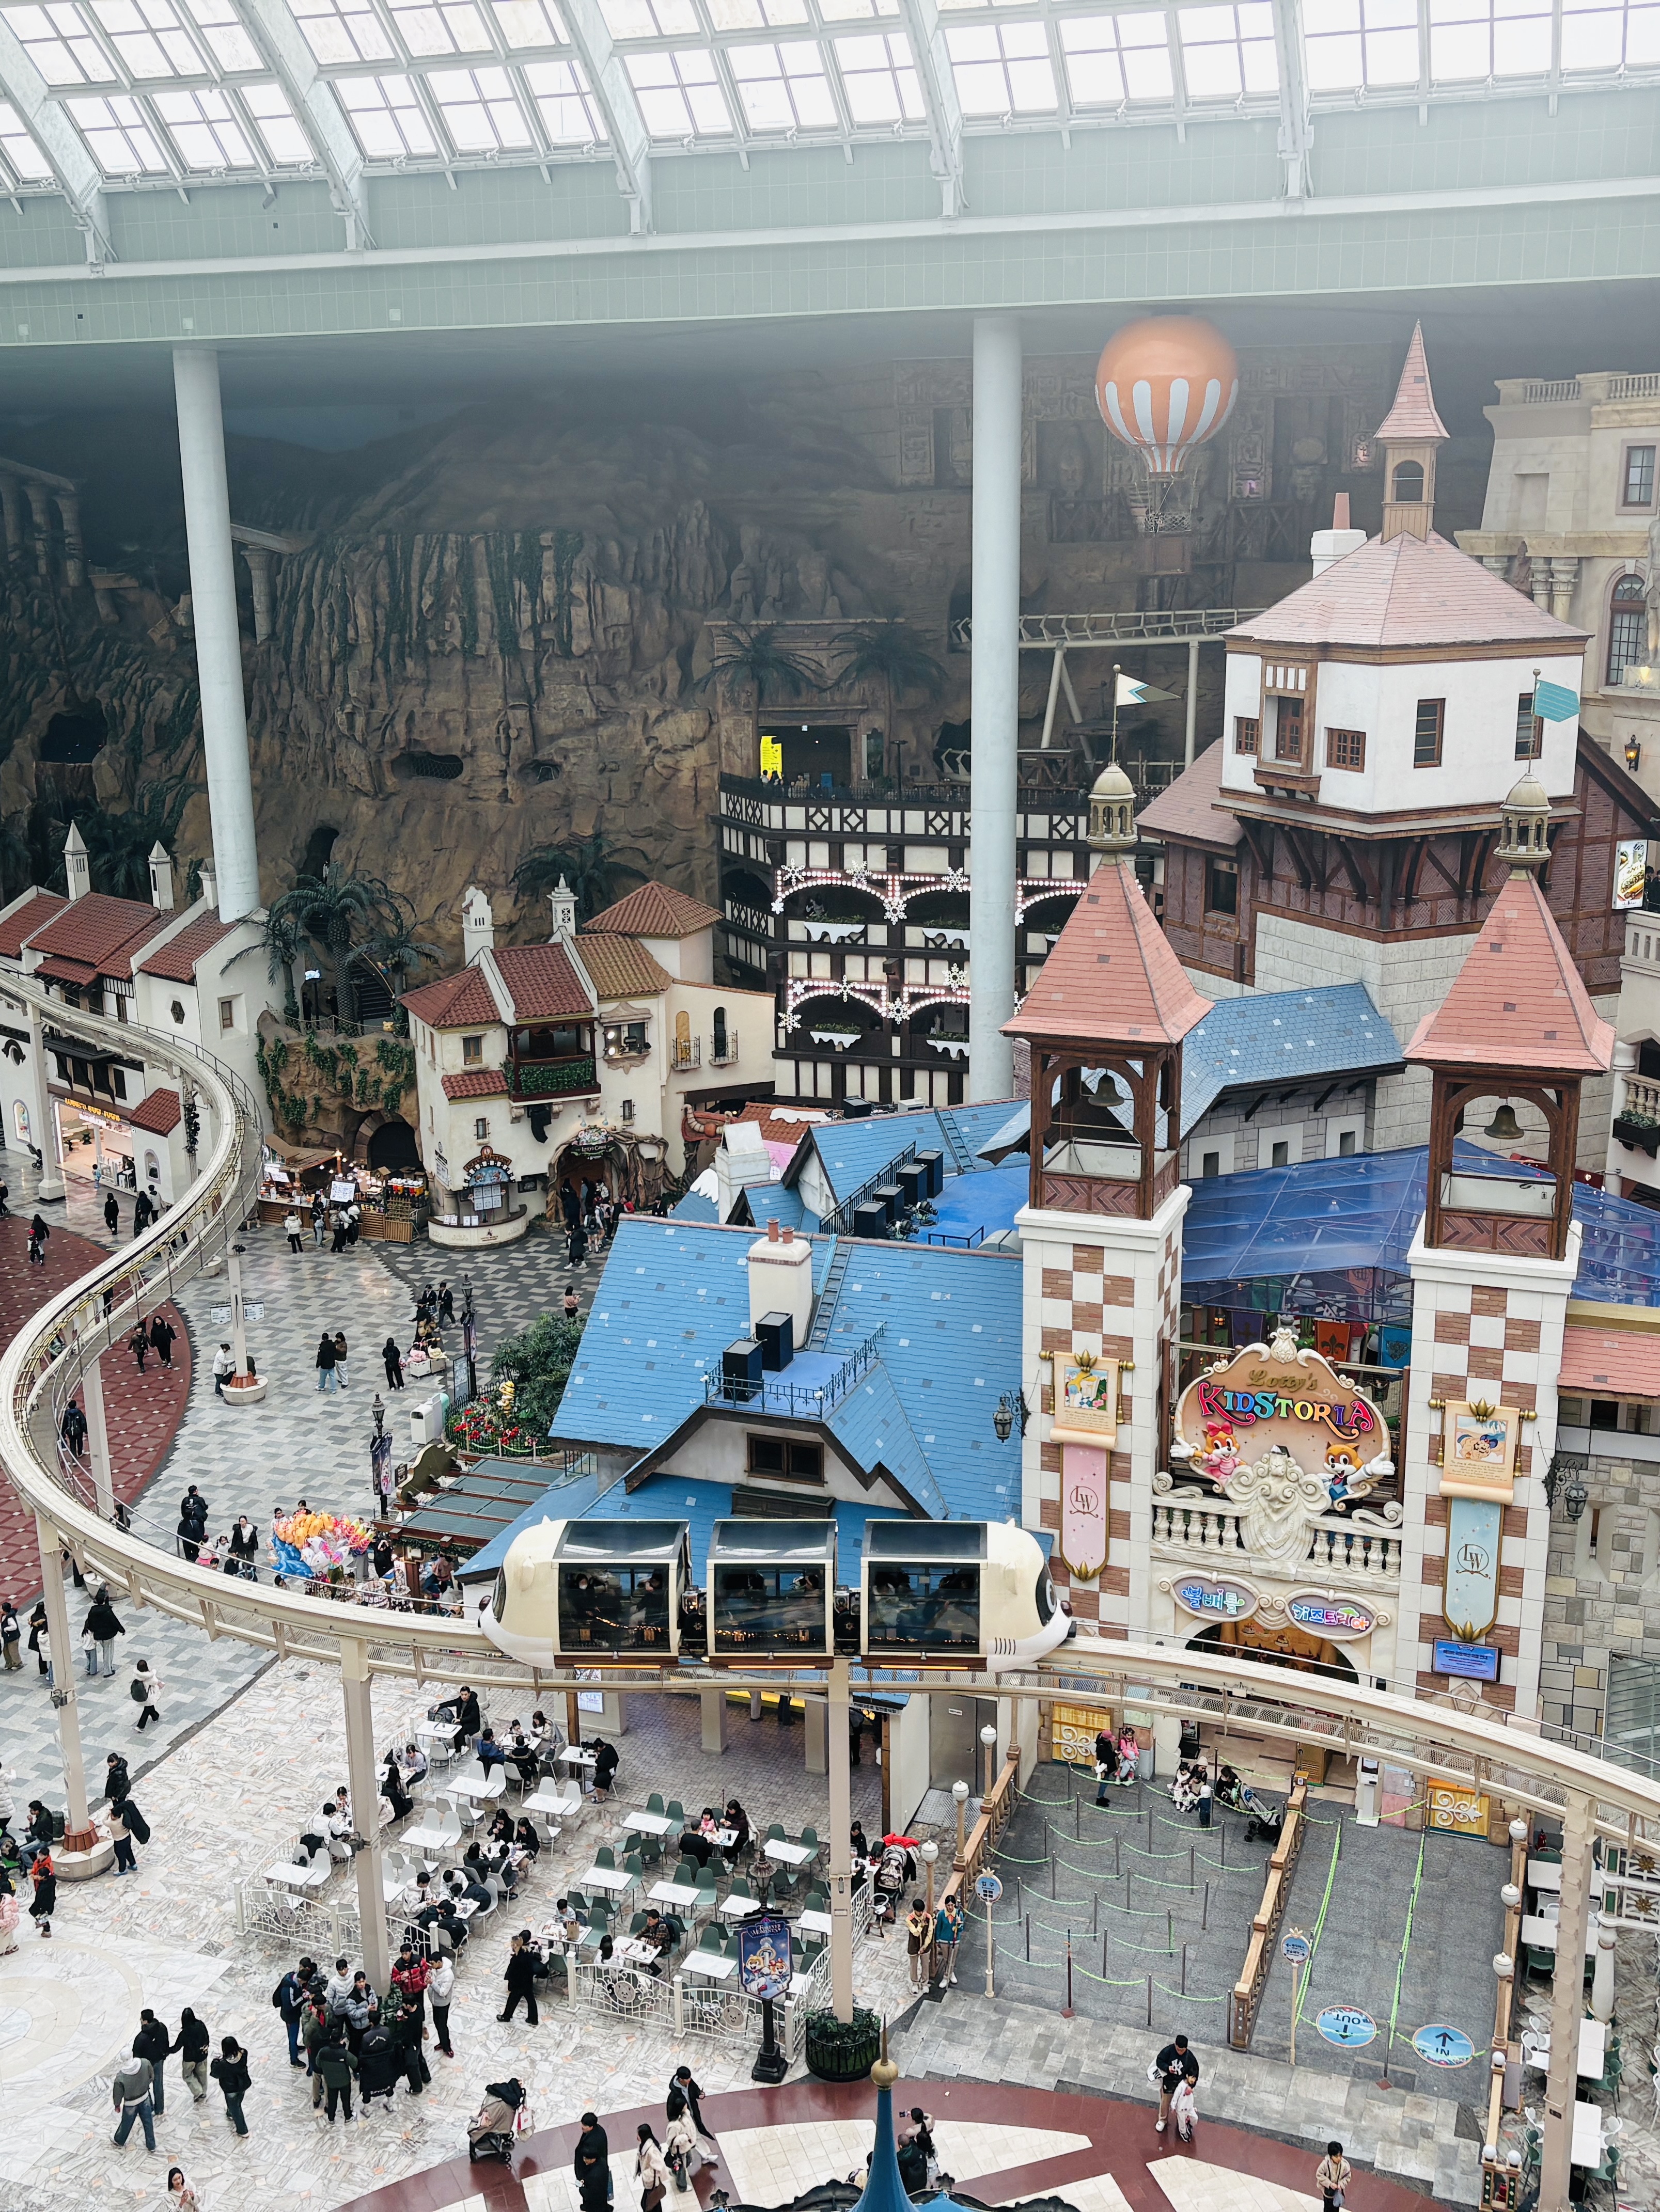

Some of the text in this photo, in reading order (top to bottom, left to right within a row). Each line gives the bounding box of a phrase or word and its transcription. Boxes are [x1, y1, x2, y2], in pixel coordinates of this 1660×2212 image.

[1247, 1369, 1318, 1393] Lotty's
[1197, 1381, 1375, 1441] KIDSTORIA
[1292, 1603, 1370, 1631] 키즈토리아
[1333, 2014, 1361, 2025] OUT
[1436, 2047, 1450, 2056] IN
